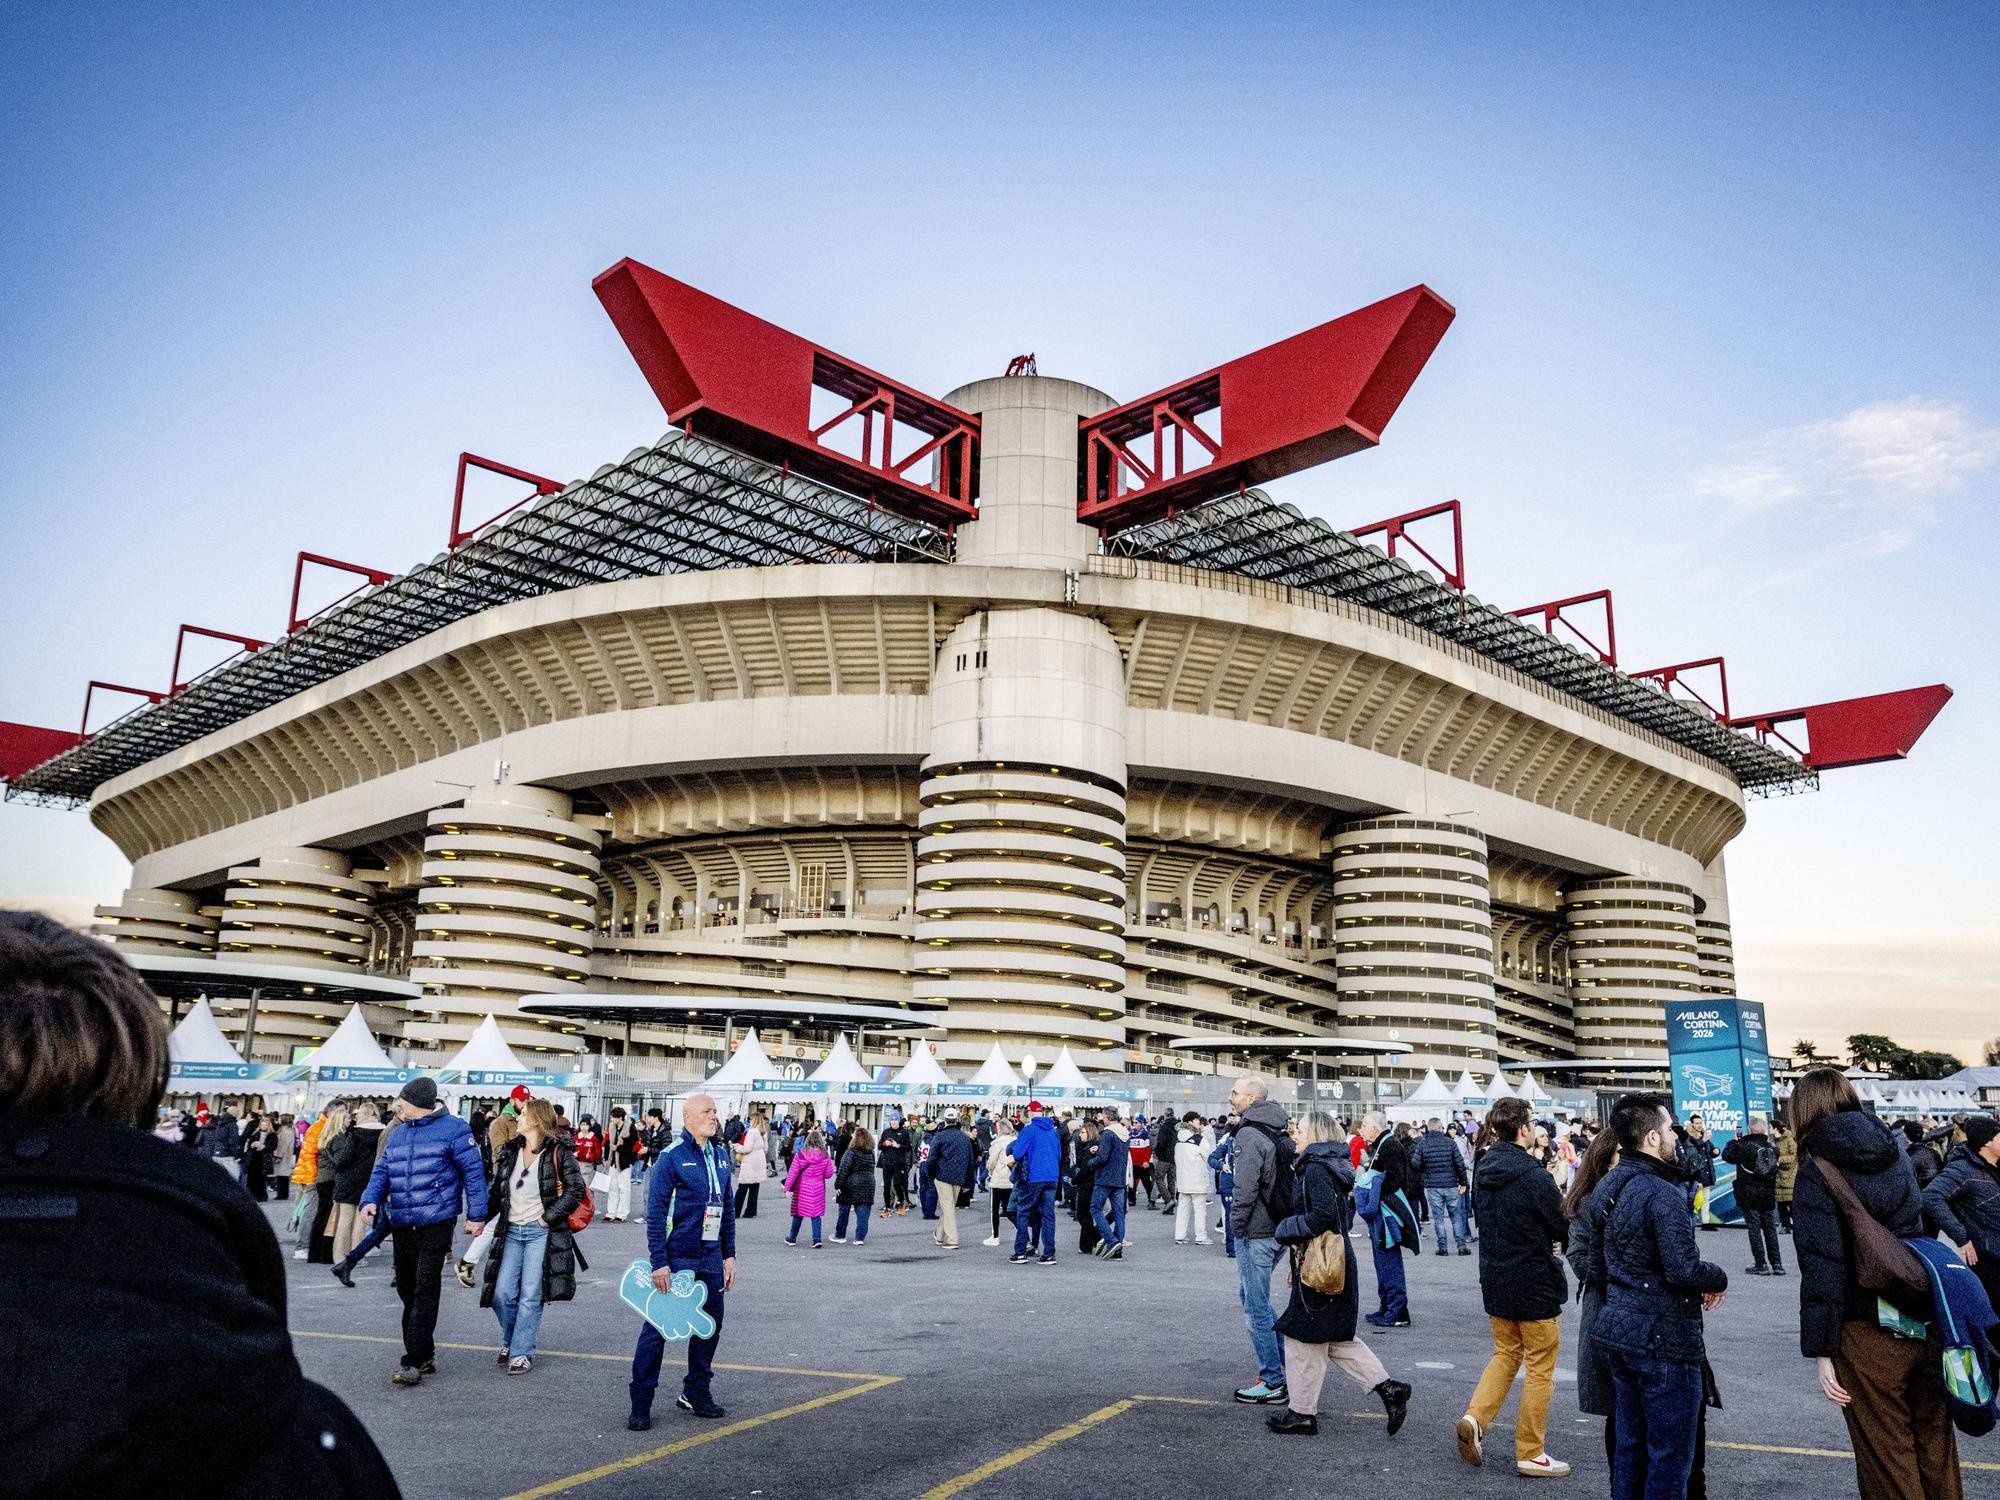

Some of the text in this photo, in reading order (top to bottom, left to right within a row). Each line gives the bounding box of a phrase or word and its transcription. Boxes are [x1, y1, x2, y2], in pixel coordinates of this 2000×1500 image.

[1675, 1011, 1719, 1021] MILANO
[1741, 1011, 1759, 1020] MILANO
[1683, 1020, 1729, 1030] CORTINA
[1692, 1029, 1714, 1038] 2026
[238, 1067, 249, 1077] C
[397, 1071, 408, 1081] C
[787, 1066, 802, 1080] 12
[545, 1075, 555, 1084] C
[811, 1083, 818, 1091] C
[894, 1085, 901, 1093] C
[978, 1086, 984, 1094] C
[1682, 1100, 1728, 1111] MILANO
